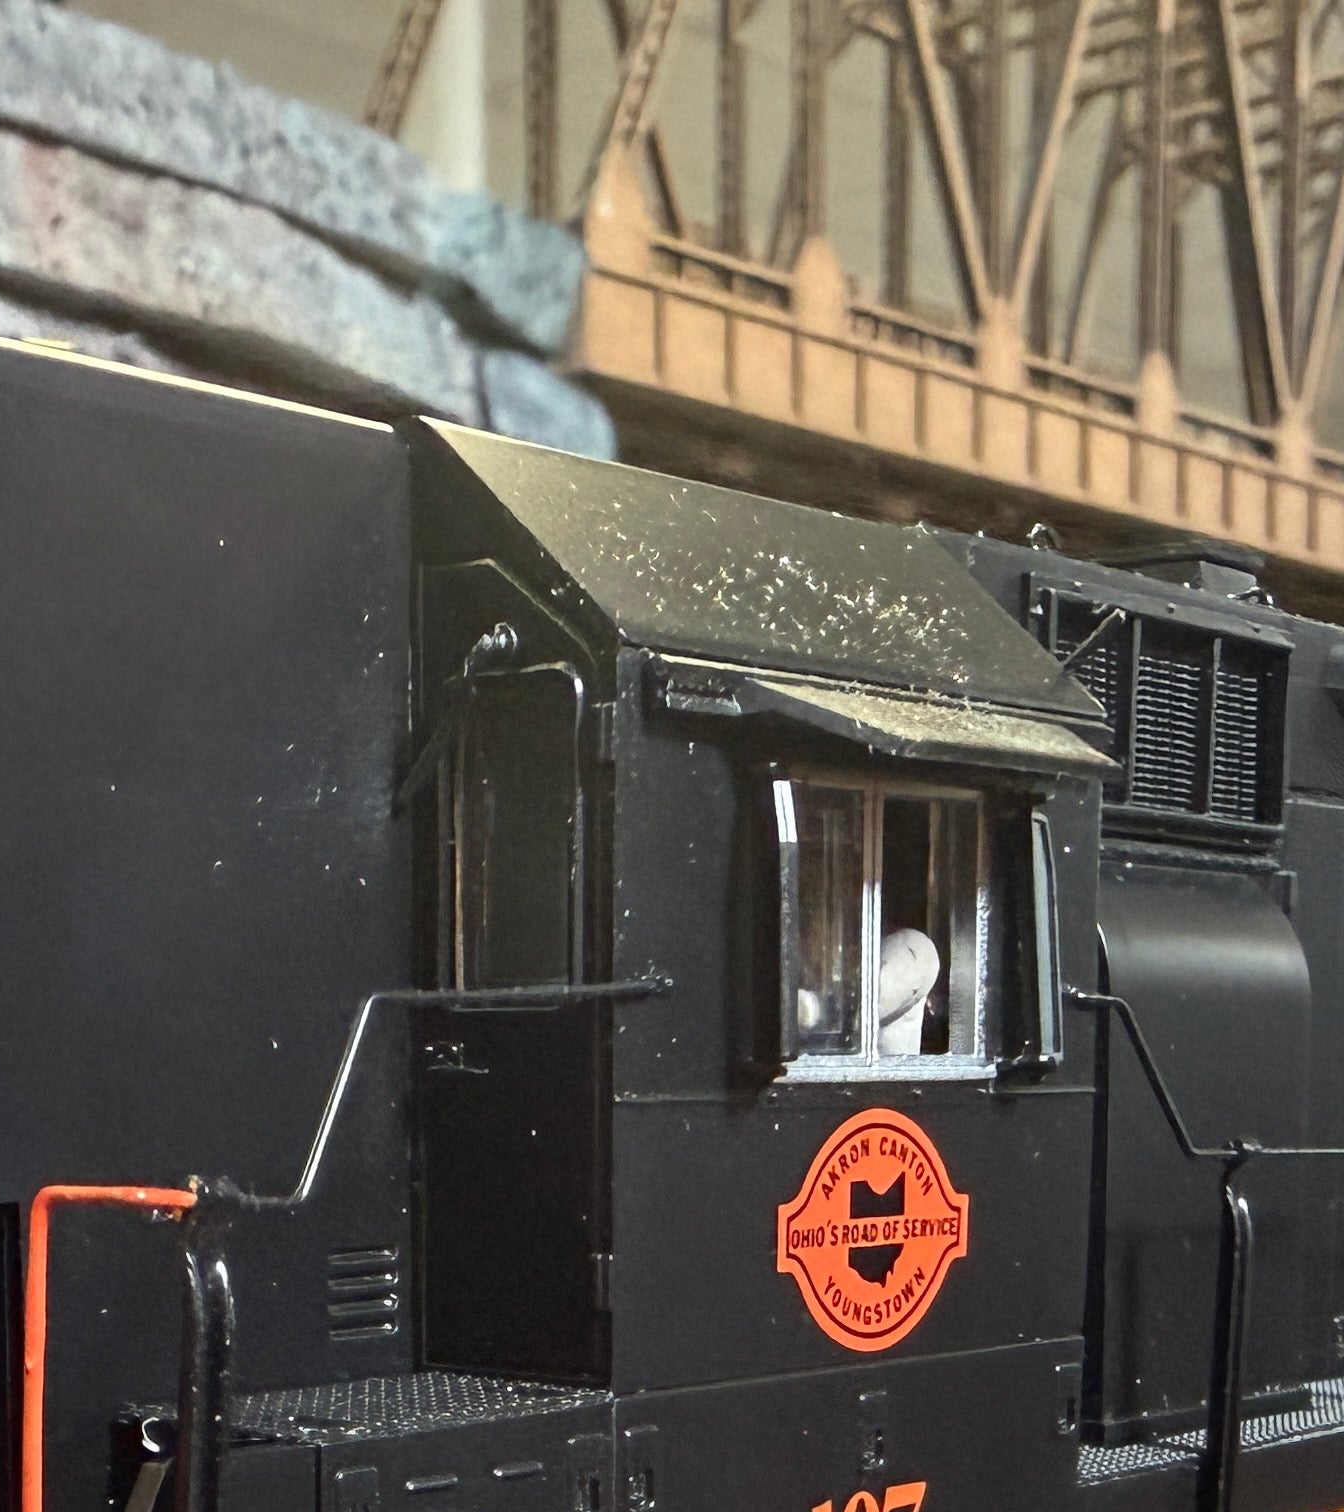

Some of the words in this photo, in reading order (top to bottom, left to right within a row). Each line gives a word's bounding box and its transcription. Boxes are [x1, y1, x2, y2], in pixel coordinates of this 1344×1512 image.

[821, 1138, 870, 1200] AKRON
[879, 1136, 934, 1196] CANTON
[791, 1219, 839, 1250] OHIO'S
[842, 1223, 879, 1244] ROAD
[882, 1220, 900, 1241] OF
[902, 1217, 957, 1240] SERVICE
[823, 1266, 926, 1326] YOUNGSTOWN
